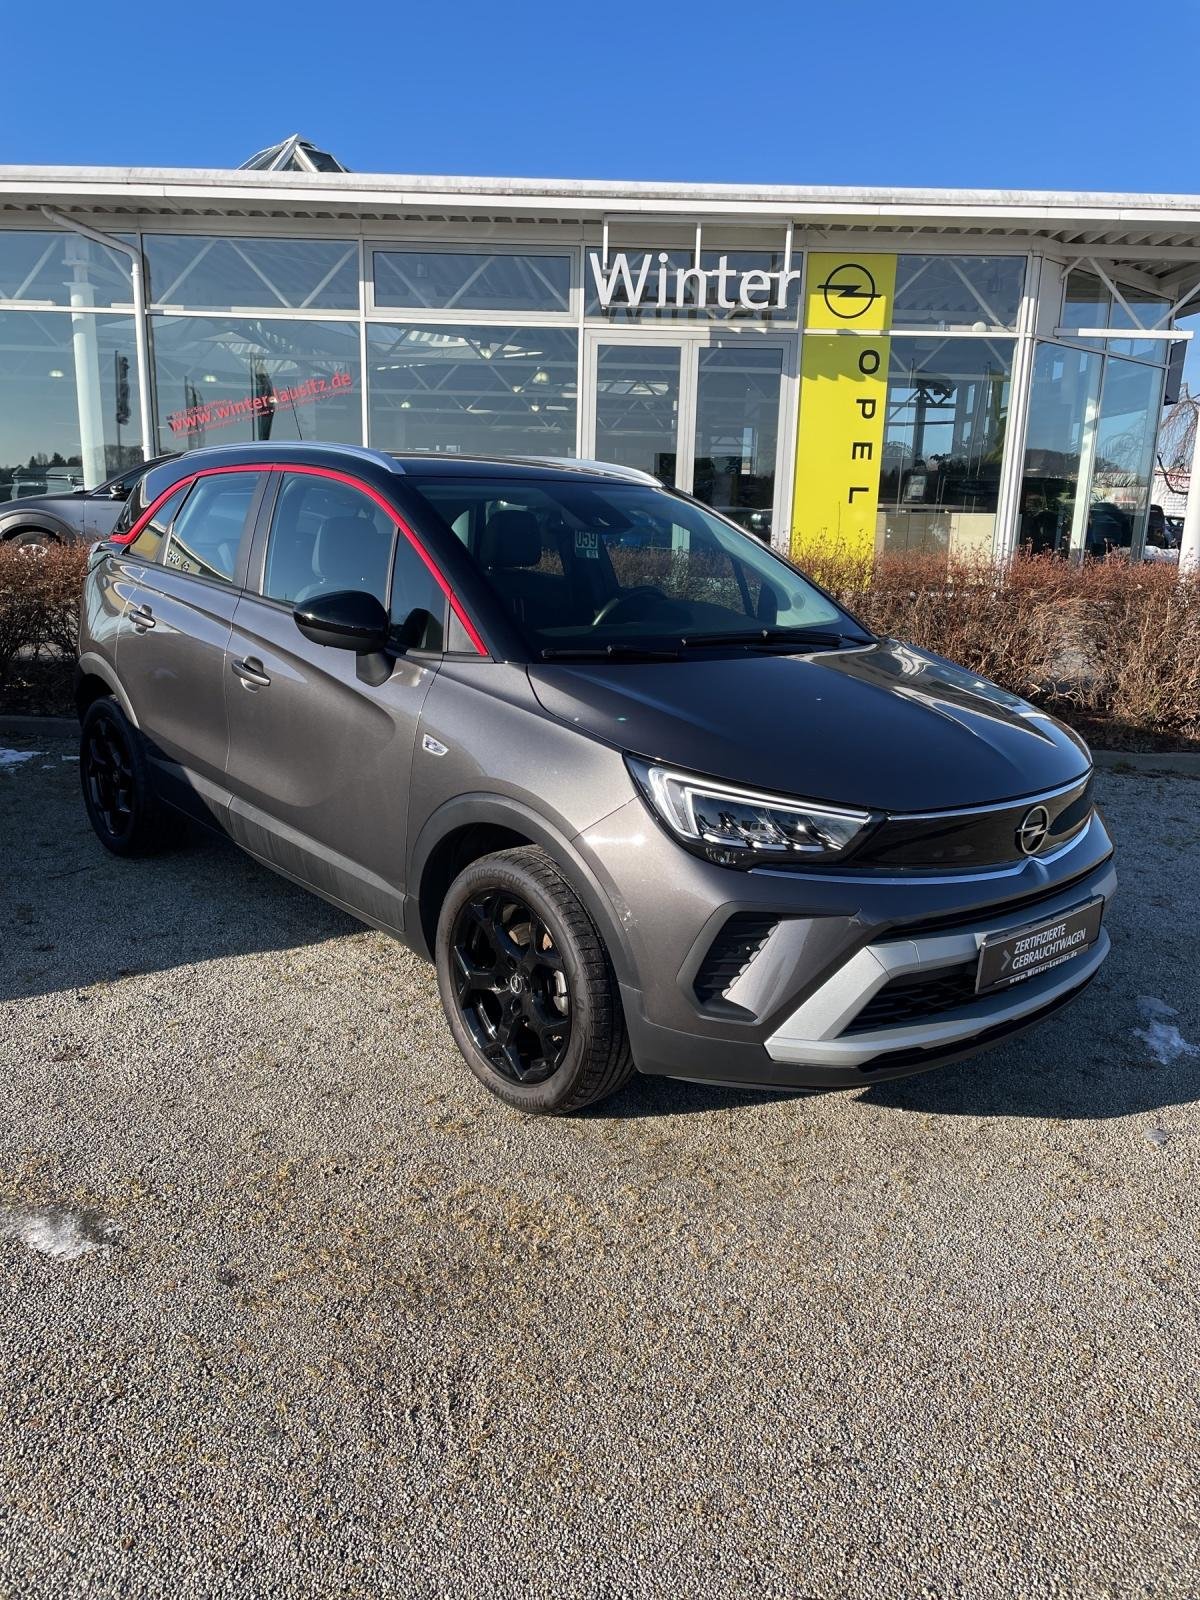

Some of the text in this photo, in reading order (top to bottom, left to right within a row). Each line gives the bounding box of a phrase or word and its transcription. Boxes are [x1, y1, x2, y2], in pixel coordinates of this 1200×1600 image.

[590, 252, 800, 309] Winter
[848, 349, 880, 504] OPEL
[1012, 928, 1086, 970] GEBRAUCHTWAGEN
[1014, 923, 1066, 954] ZERTIFIZIERTE
